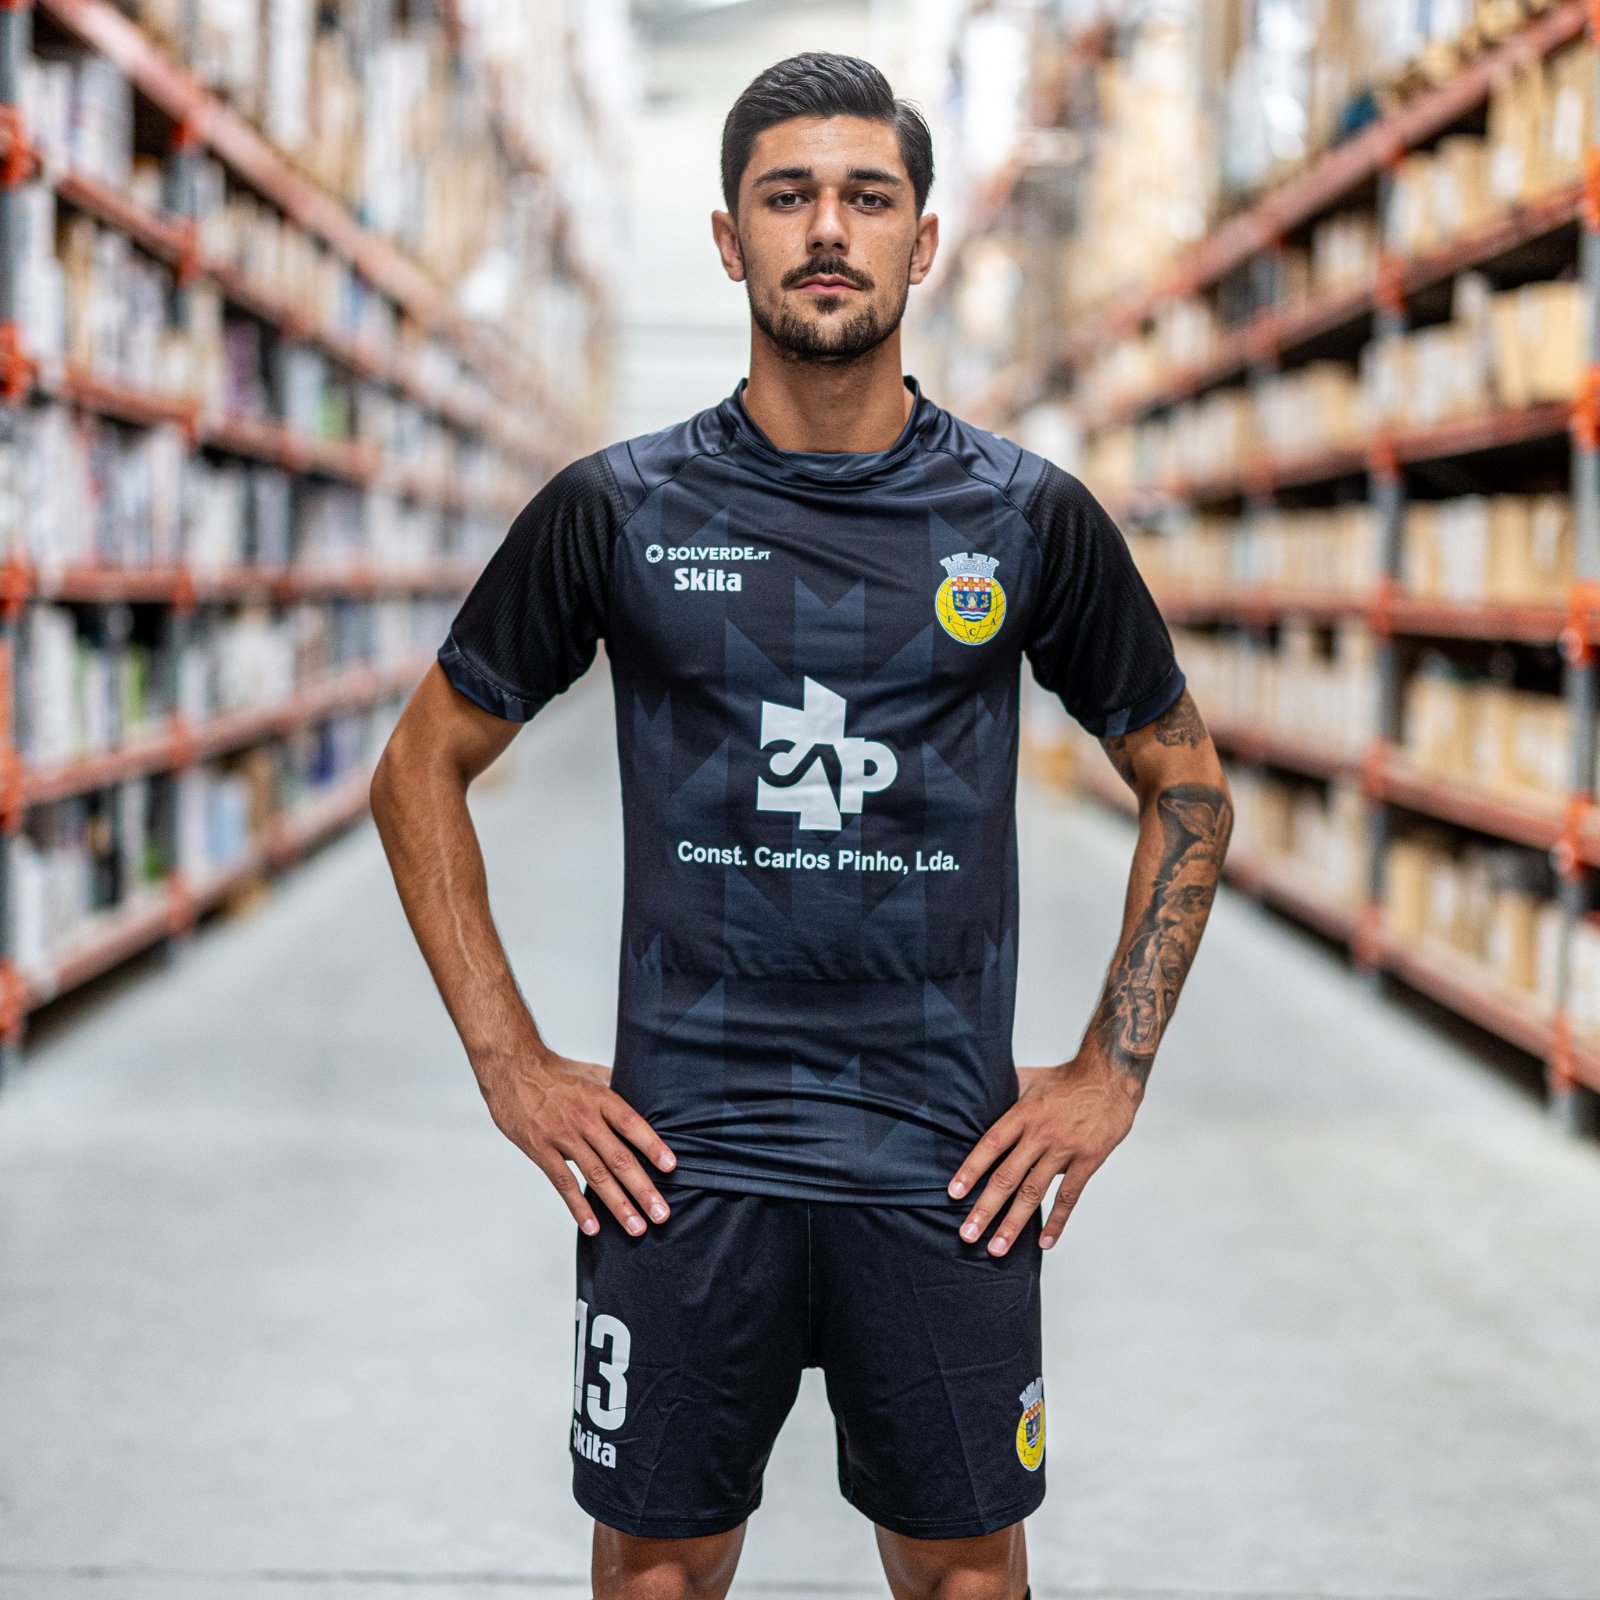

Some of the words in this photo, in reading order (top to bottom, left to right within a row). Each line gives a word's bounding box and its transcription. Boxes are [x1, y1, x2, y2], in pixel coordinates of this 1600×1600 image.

[667, 546, 771, 561] SOLVERDE.PT
[674, 567, 742, 592] Skita
[969, 628, 976, 636] C
[990, 617, 997, 626] A
[677, 840, 748, 866] Const.
[754, 846, 831, 870] Carlos
[838, 849, 909, 875] Pinho,
[915, 850, 960, 872] Lda.
[575, 1298, 631, 1431] 13
